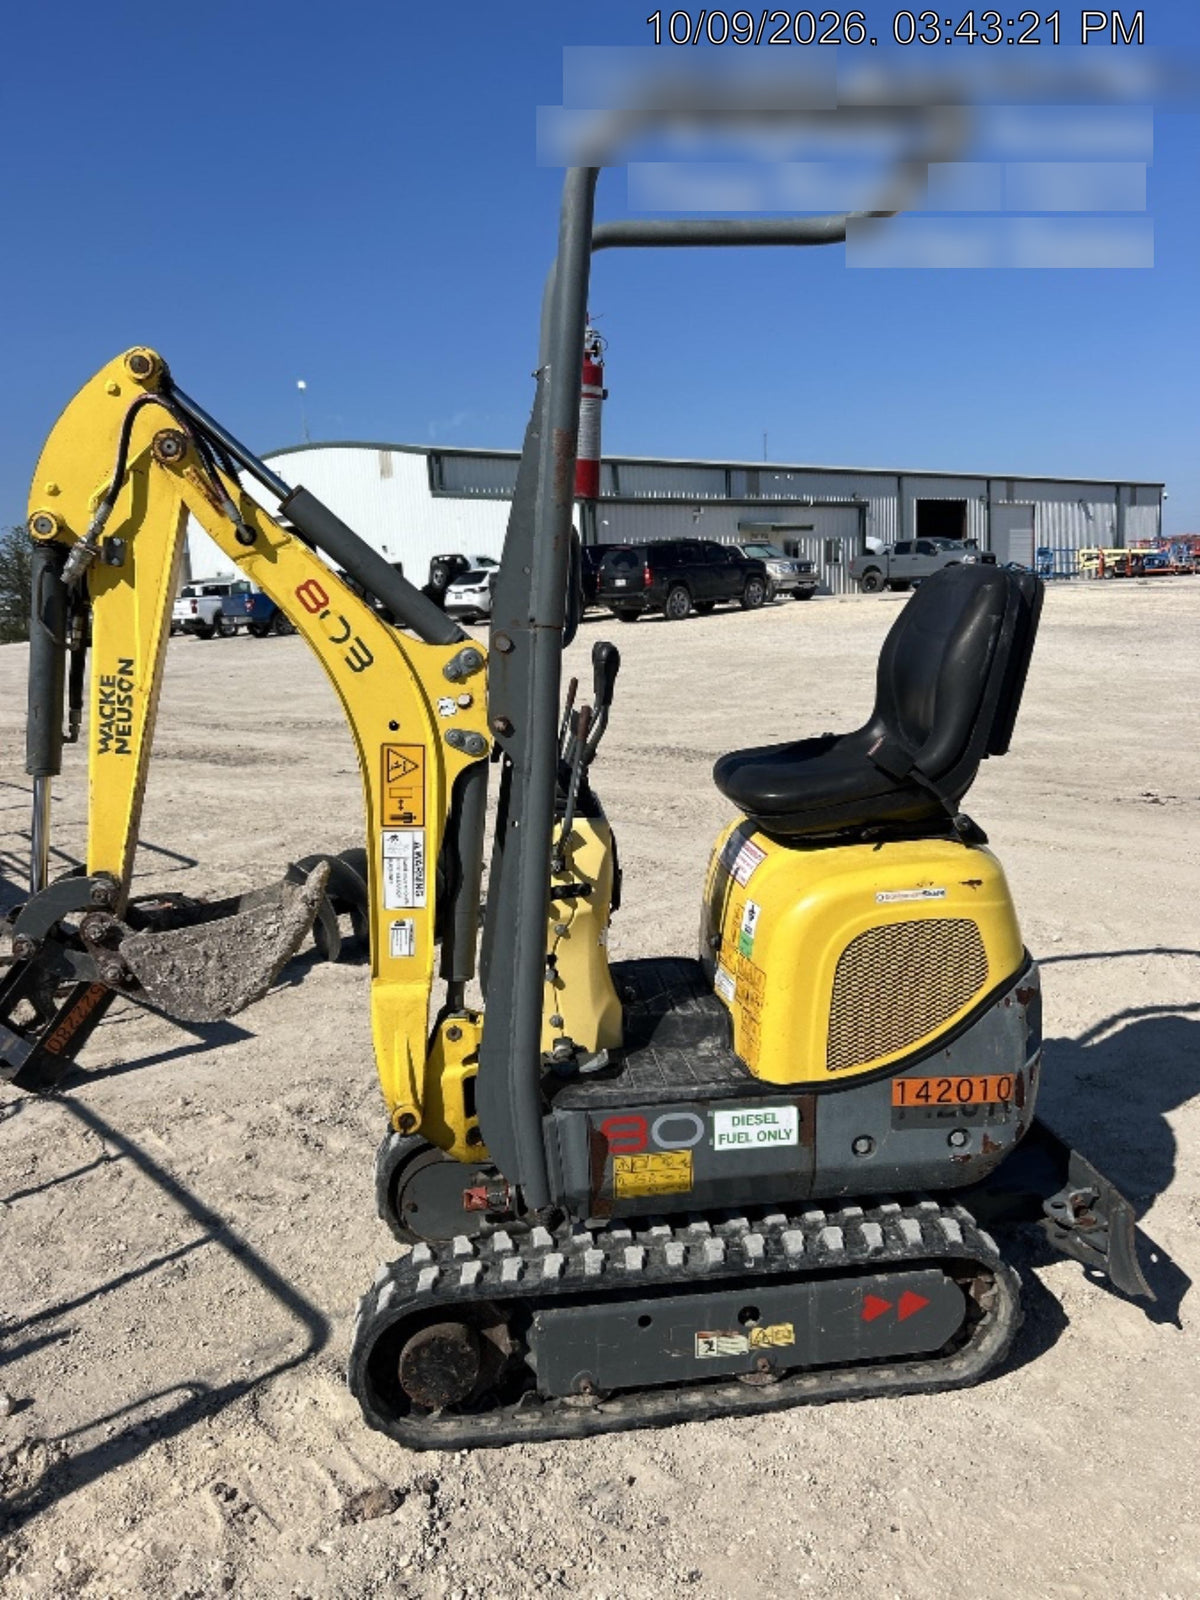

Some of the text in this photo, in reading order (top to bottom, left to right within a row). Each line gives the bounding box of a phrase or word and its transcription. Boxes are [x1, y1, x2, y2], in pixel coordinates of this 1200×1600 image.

[98, 675, 116, 755] WACKE
[115, 658, 134, 754] NEUSON
[897, 1077, 1011, 1104] 142010
[732, 1112, 779, 1127] DIESEL
[718, 1128, 793, 1145] FUEL ONLY
